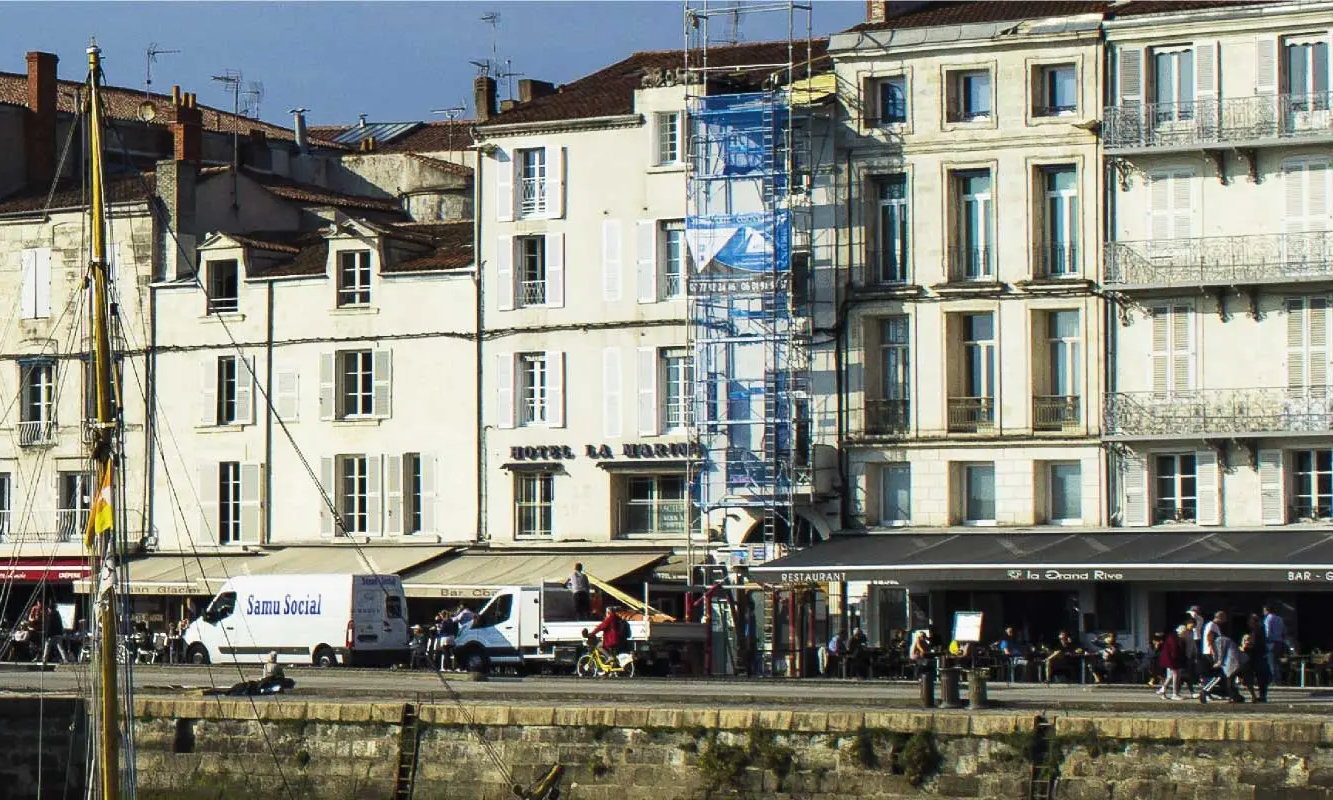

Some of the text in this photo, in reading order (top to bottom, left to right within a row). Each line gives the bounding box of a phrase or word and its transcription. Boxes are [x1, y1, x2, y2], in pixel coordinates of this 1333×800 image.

[510, 445, 575, 460] HOTEL
[585, 444, 614, 459] LA
[781, 572, 846, 582] RESTAURANT
[1045, 570, 1089, 580] Grand
[1094, 570, 1124, 580] Rive
[1288, 571, 1312, 581] BAR
[247, 594, 321, 615] Samu Social
